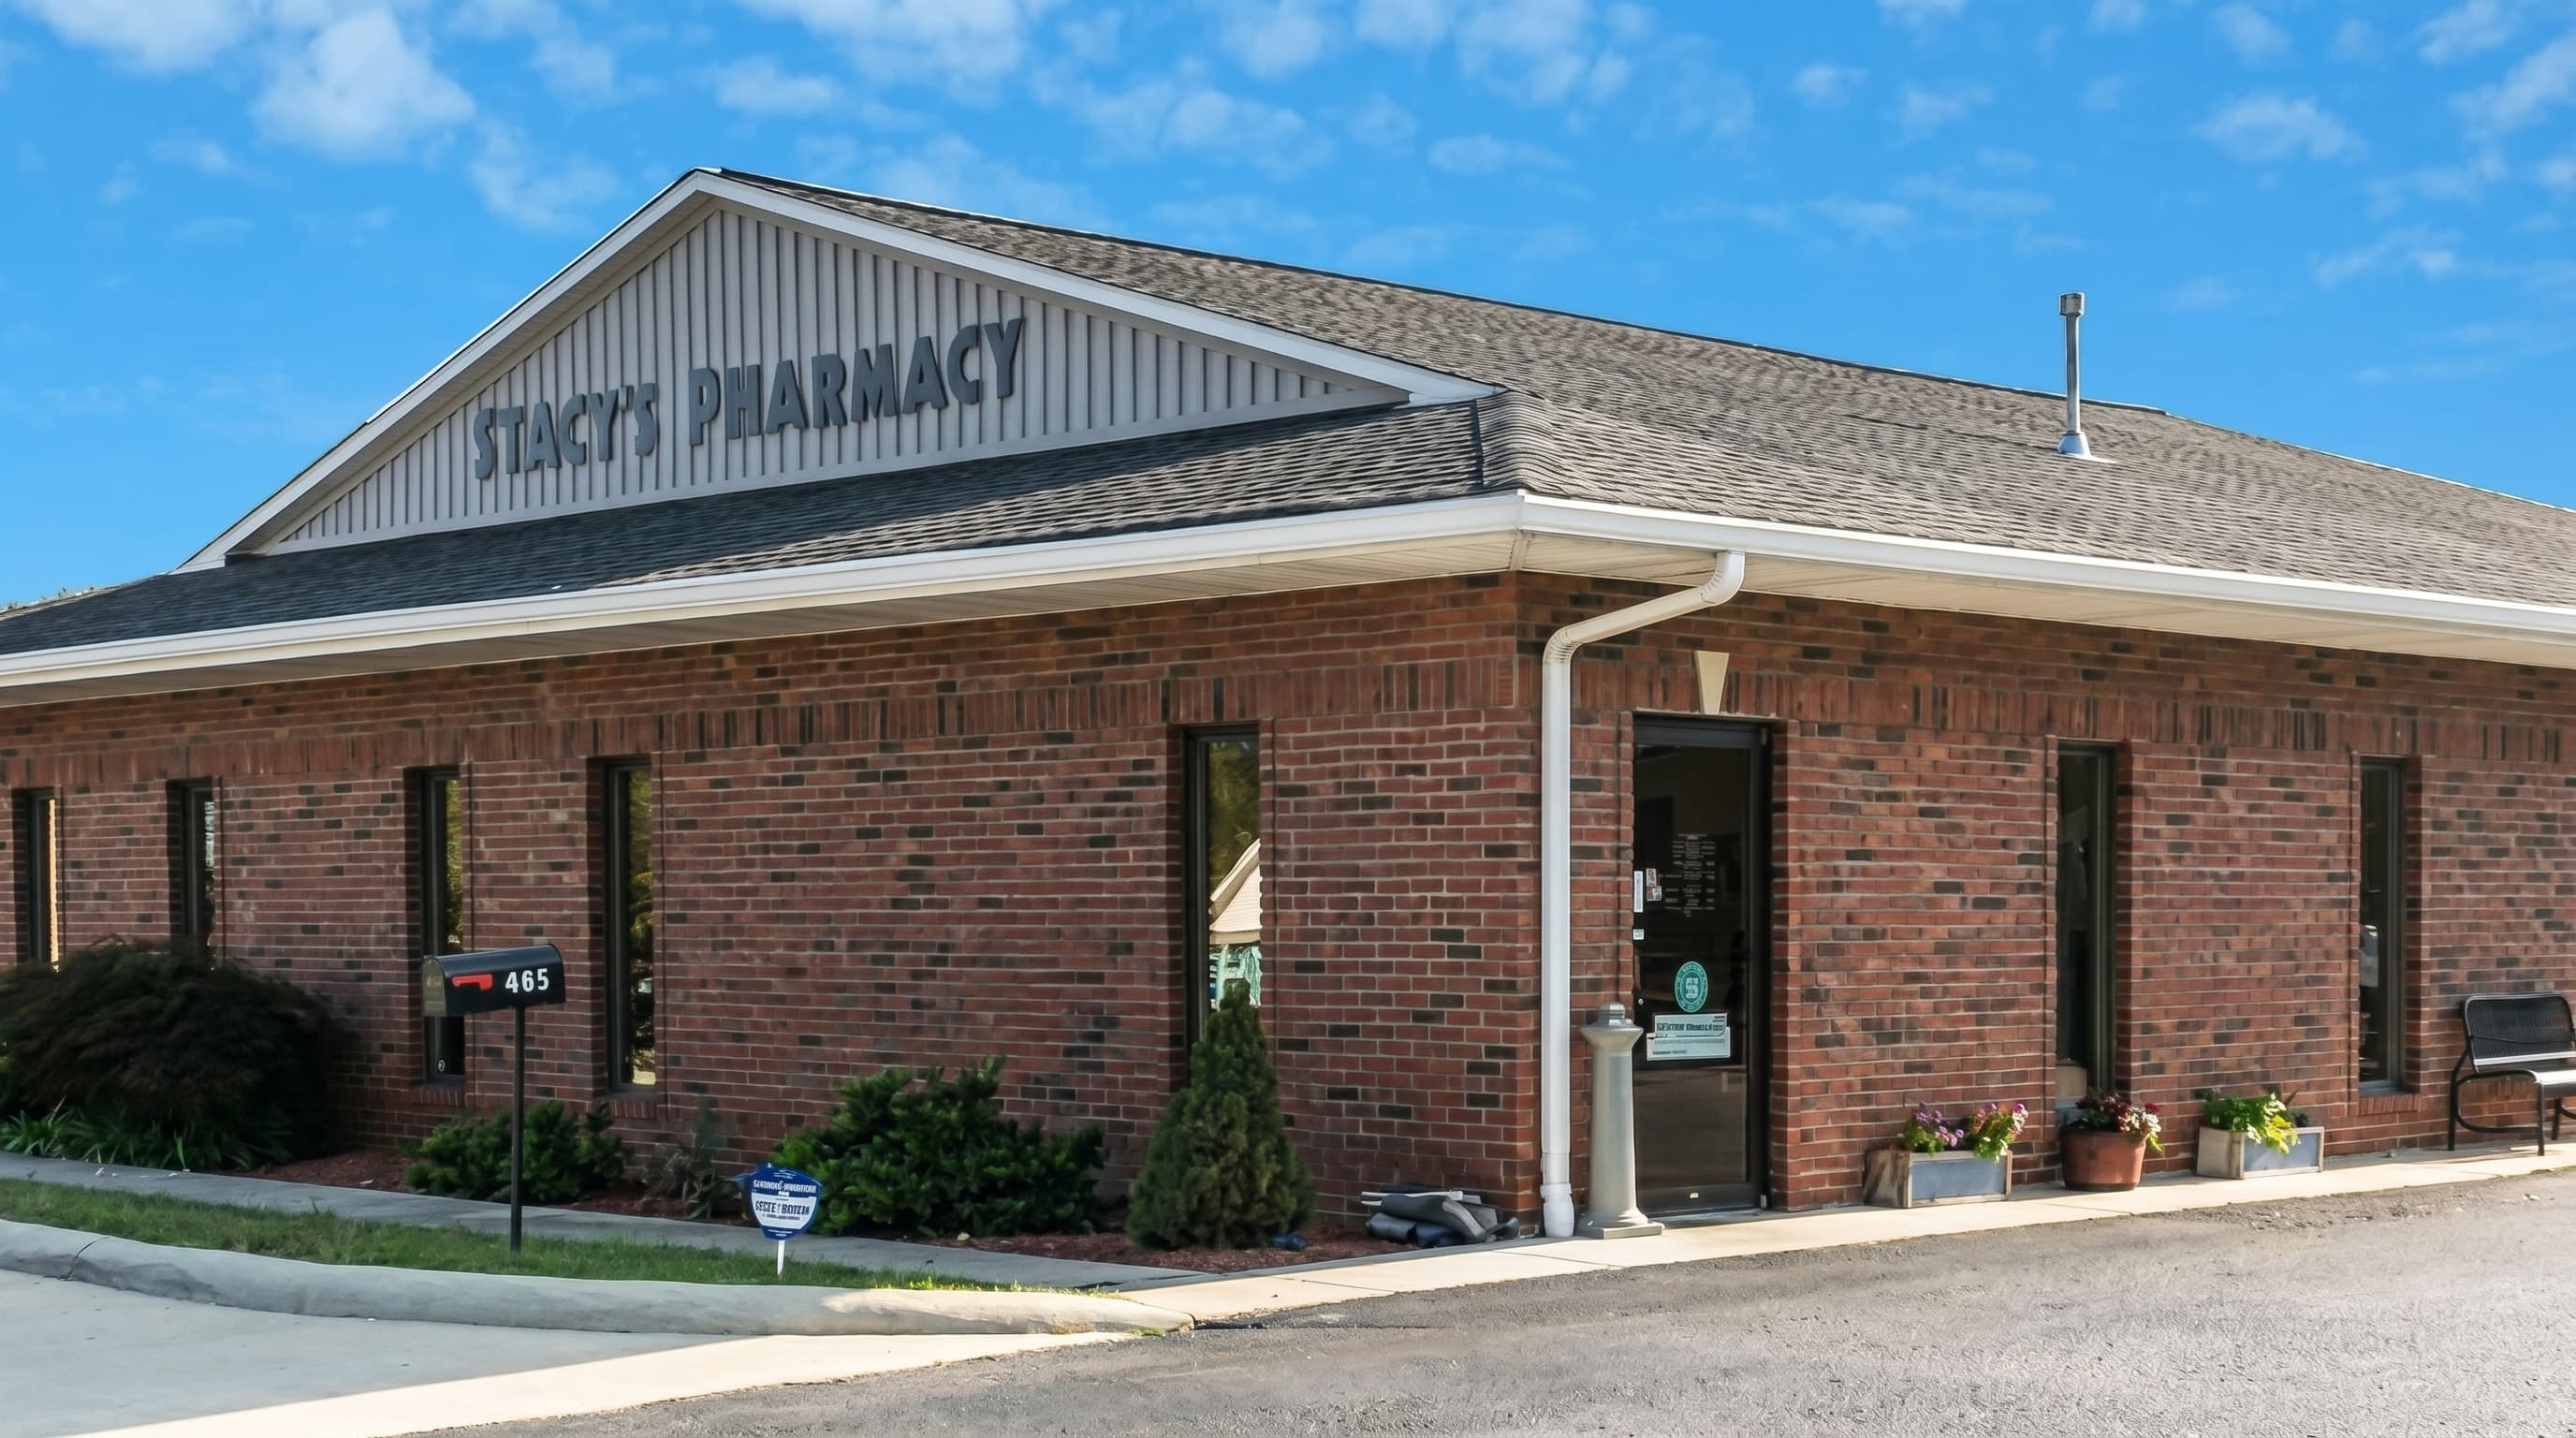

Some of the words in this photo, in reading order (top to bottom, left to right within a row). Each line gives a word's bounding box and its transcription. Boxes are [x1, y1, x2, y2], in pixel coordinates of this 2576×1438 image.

[474, 382, 656, 480] STACY'S
[689, 318, 1024, 447] PHARMACY
[505, 967, 549, 993] 465
